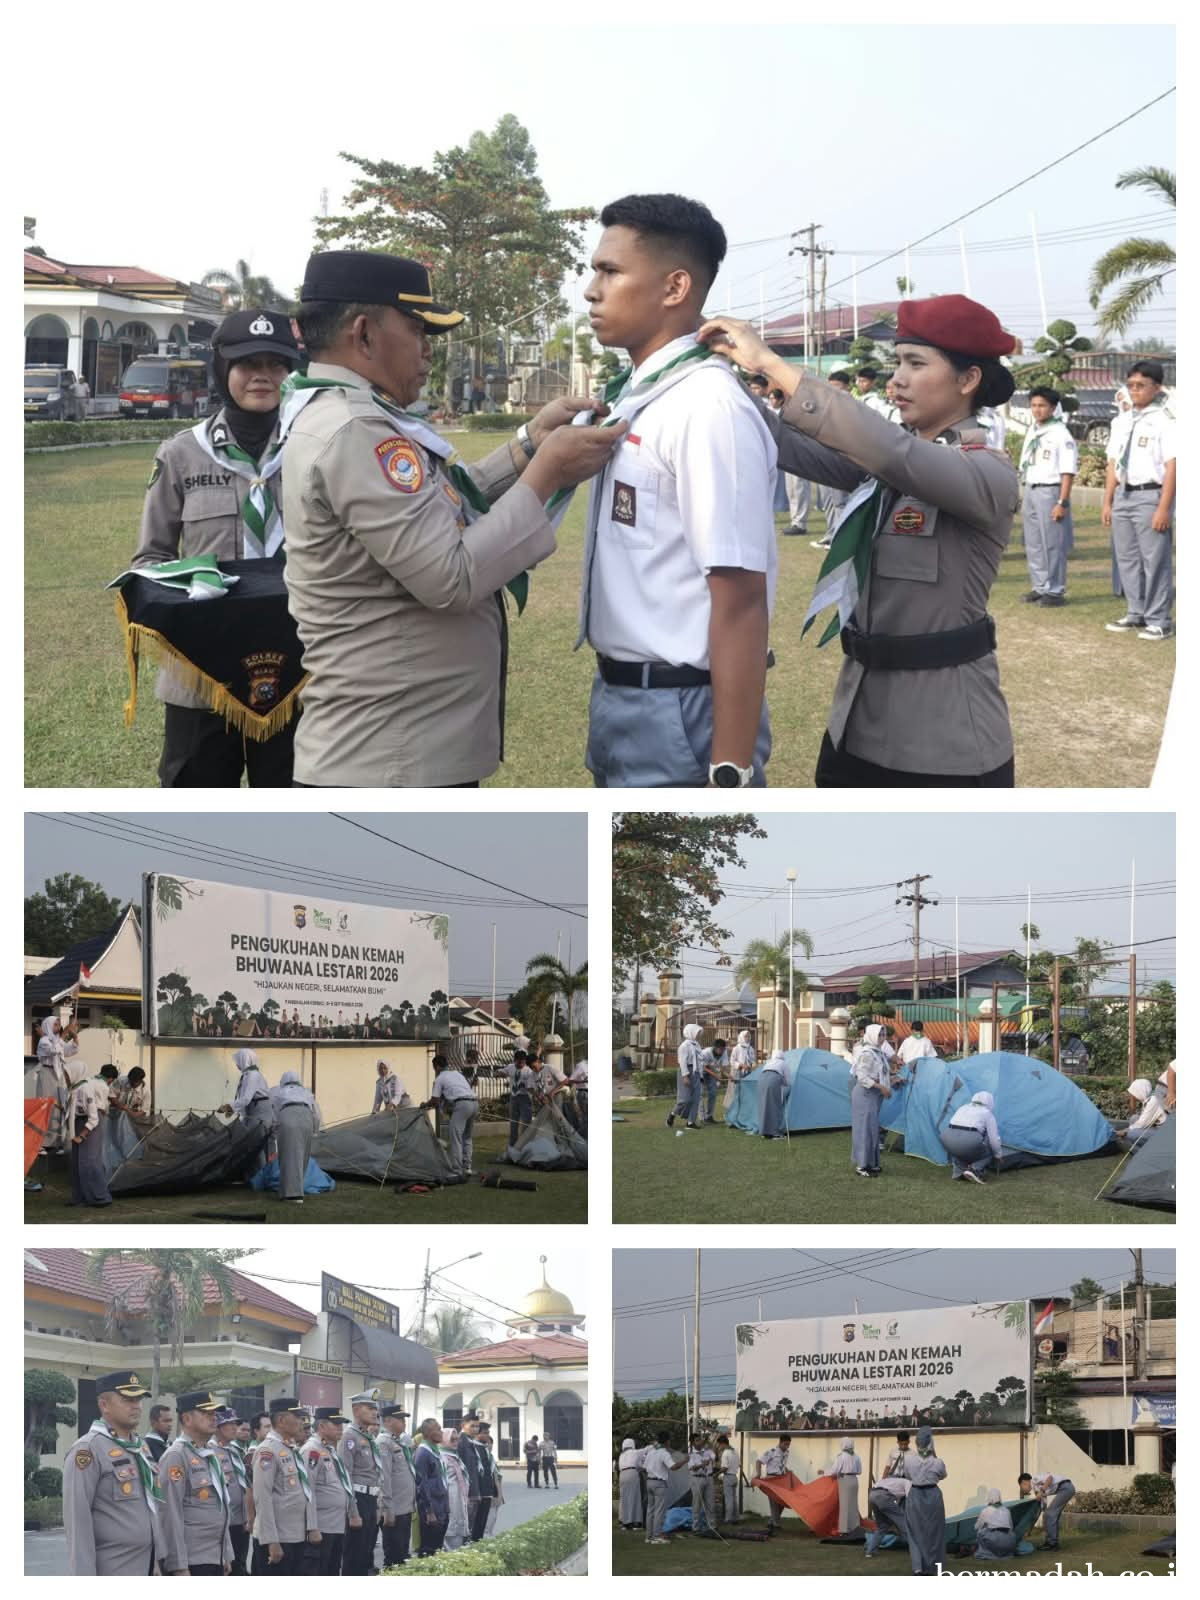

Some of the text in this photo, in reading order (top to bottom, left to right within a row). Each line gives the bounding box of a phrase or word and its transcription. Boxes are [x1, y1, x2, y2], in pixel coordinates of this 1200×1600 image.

[184, 474, 231, 490] SHELLY
[231, 933, 404, 964] PENGUKUHAN DAN KEMAH
[236, 956, 399, 982] BHUWANA LESTARI 2026
[323, 985, 366, 994] SELAMATKAN
[789, 1345, 962, 1368] PENGUKUHAN DAN KEMAH
[792, 1362, 954, 1383] BHUWANA LESTARI 2026
[869, 1382, 915, 1391] SELAMATKAN
